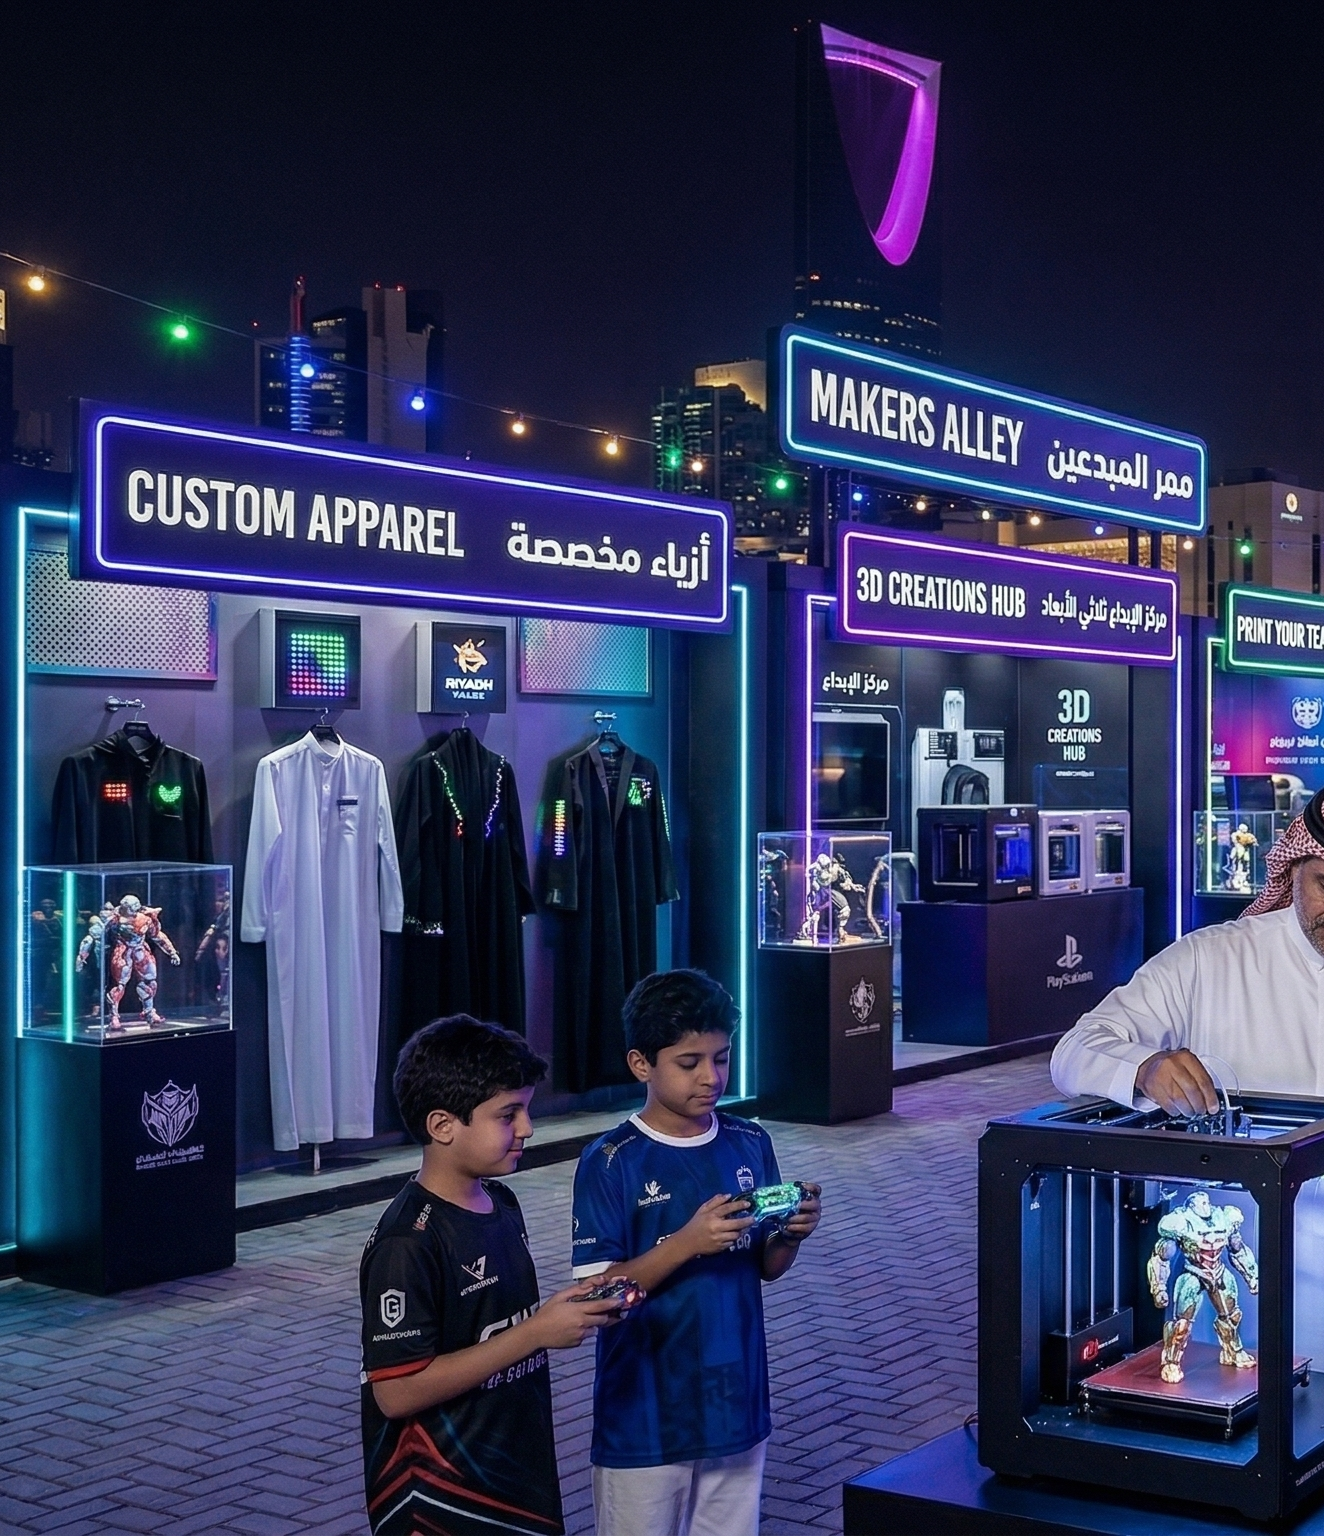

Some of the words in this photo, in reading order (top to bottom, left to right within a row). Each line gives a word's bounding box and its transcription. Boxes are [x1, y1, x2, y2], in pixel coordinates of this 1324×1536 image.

[811, 368, 935, 448] MAKERS
[942, 403, 1024, 466] ALLEY
[1047, 440, 1148, 492] المبدعين
[1153, 469, 1194, 501] ممر
[128, 469, 295, 539] CUSTOM
[307, 494, 465, 557] APPAREL
[507, 522, 642, 574] مخصصة
[650, 532, 711, 590] أزياء
[856, 566, 883, 603] 3D
[888, 571, 988, 615] CREATIONS
[991, 584, 1027, 618] HUB
[1041, 589, 1077, 624] الأبعاد
[1144, 605, 1168, 634] مركز
[1237, 615, 1274, 645] PRINT
[1274, 618, 1306, 648] YOUR
[822, 671, 860, 696] الإبداع
[862, 673, 889, 695] مركز
[1057, 689, 1091, 724] 3D
[1047, 728, 1102, 743] CREATIONS
[1063, 745, 1086, 761] HUB
